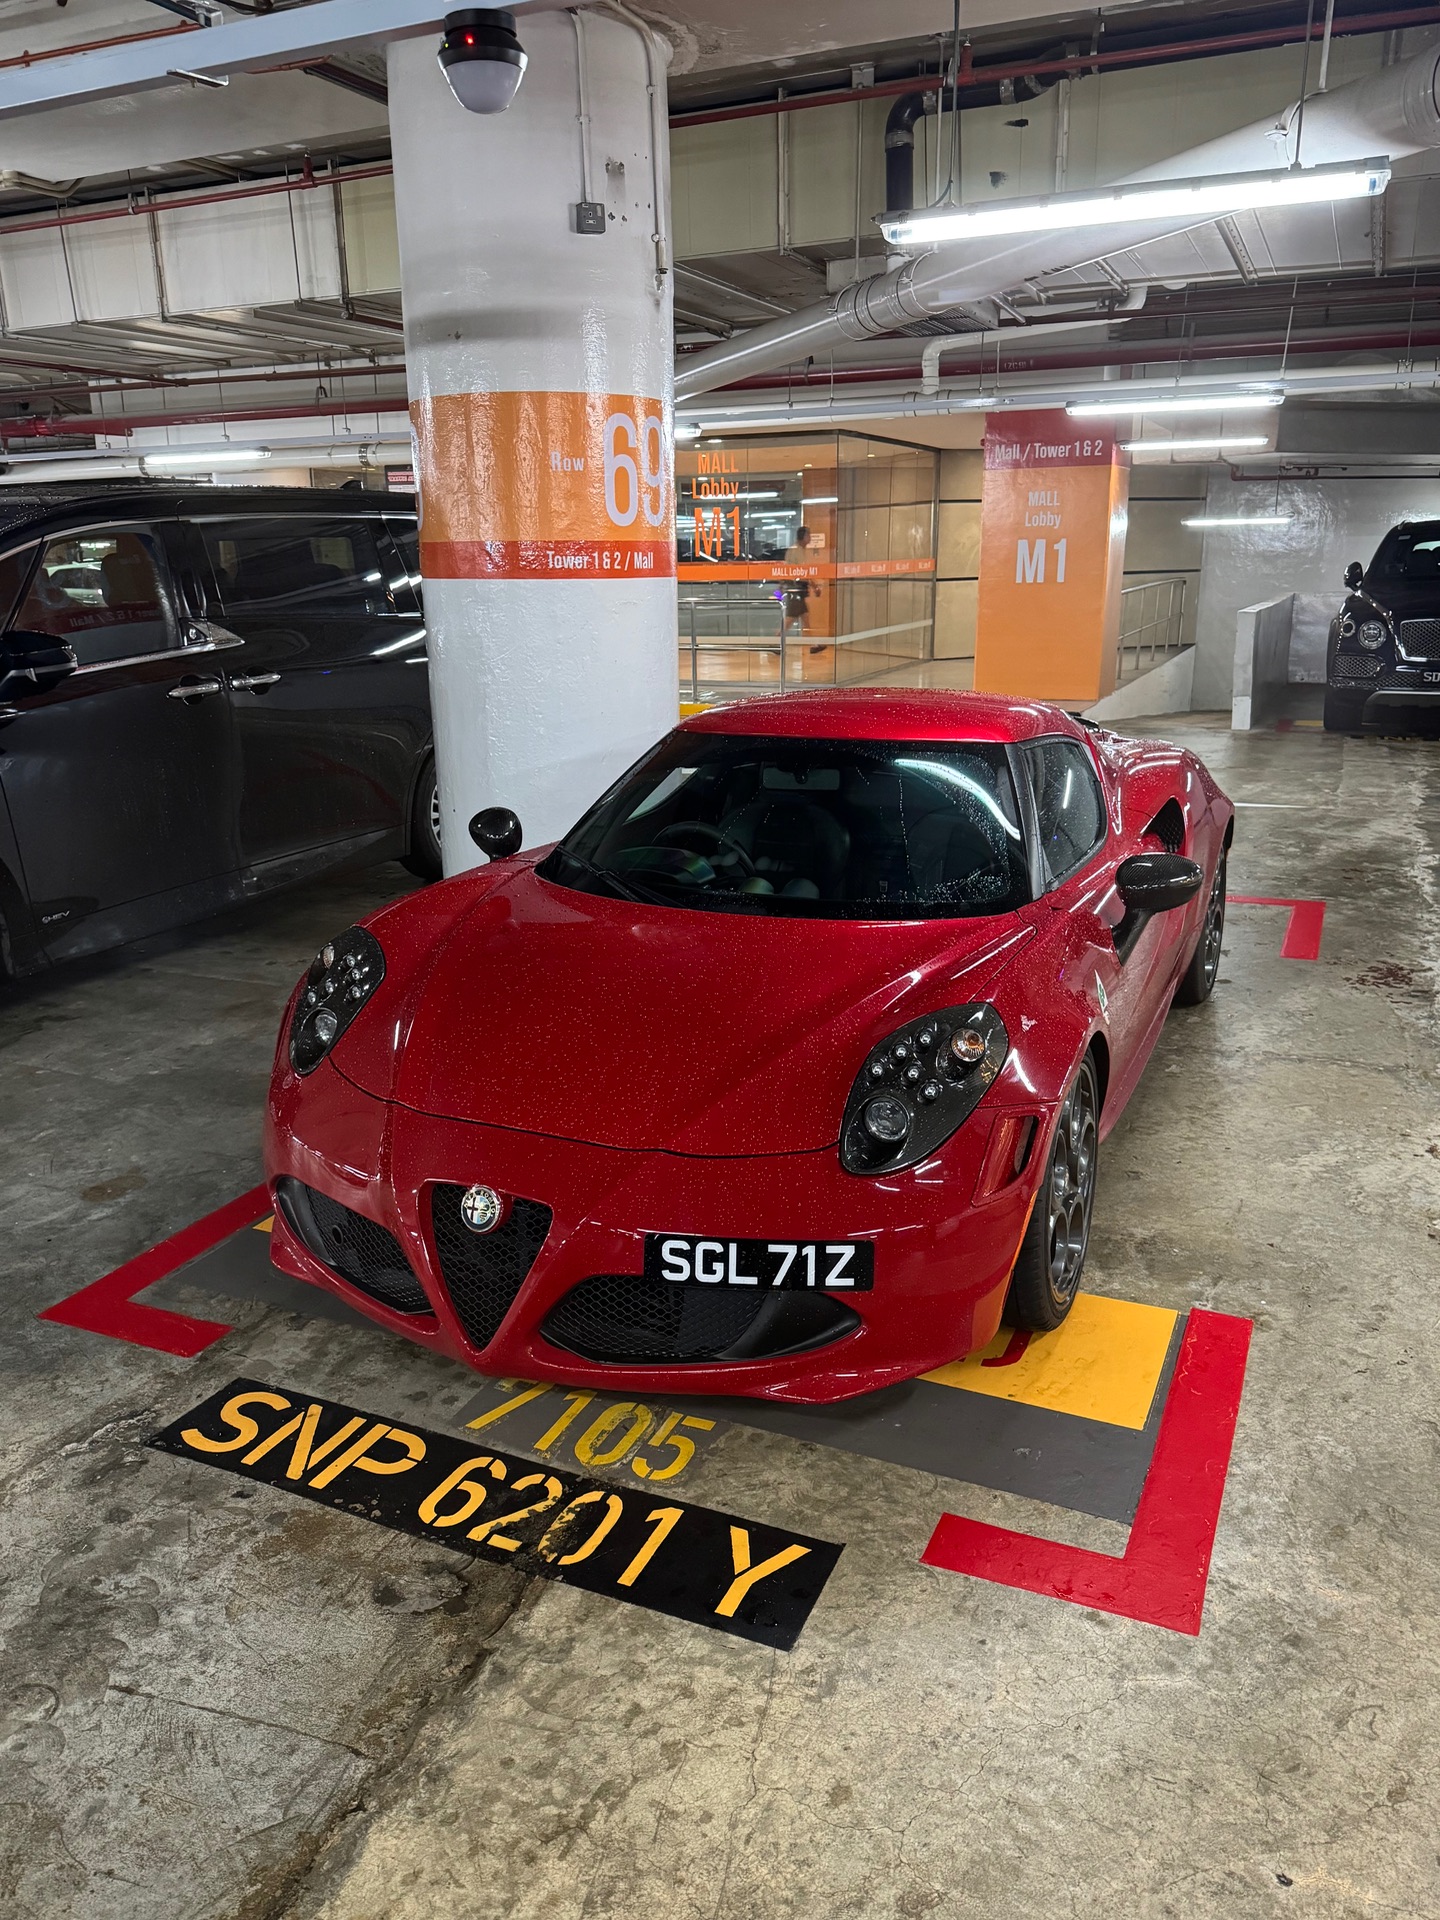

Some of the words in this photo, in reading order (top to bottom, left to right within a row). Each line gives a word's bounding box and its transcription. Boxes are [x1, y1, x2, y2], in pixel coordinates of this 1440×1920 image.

[995, 443, 1020, 461] Mall
[1022, 443, 1030, 461] /
[1033, 442, 1072, 459] Tower
[1074, 441, 1080, 457] 1
[1083, 440, 1091, 457] &
[1094, 439, 1103, 456] 2
[550, 450, 584, 472] Row
[603, 412, 665, 527] 69
[697, 451, 739, 474] MALL
[692, 476, 739, 502] Lobby
[1028, 490, 1061, 507] MALL
[1024, 511, 1062, 529] Lobby
[546, 550, 589, 570] Tower
[592, 551, 599, 569] 1
[602, 551, 611, 569] &
[613, 551, 622, 570] 2
[624, 551, 631, 571] /
[633, 551, 654, 570] Mall
[771, 567, 788, 577] MALL
[789, 567, 808, 578] Lobby
[661, 1239, 758, 1285] SGL
[767, 1244, 856, 1287] 71Z
[465, 1379, 717, 1481] 7105
[180, 1390, 427, 1490] SNP
[417, 1455, 685, 1587] 6201
[713, 1525, 812, 1618] Y
